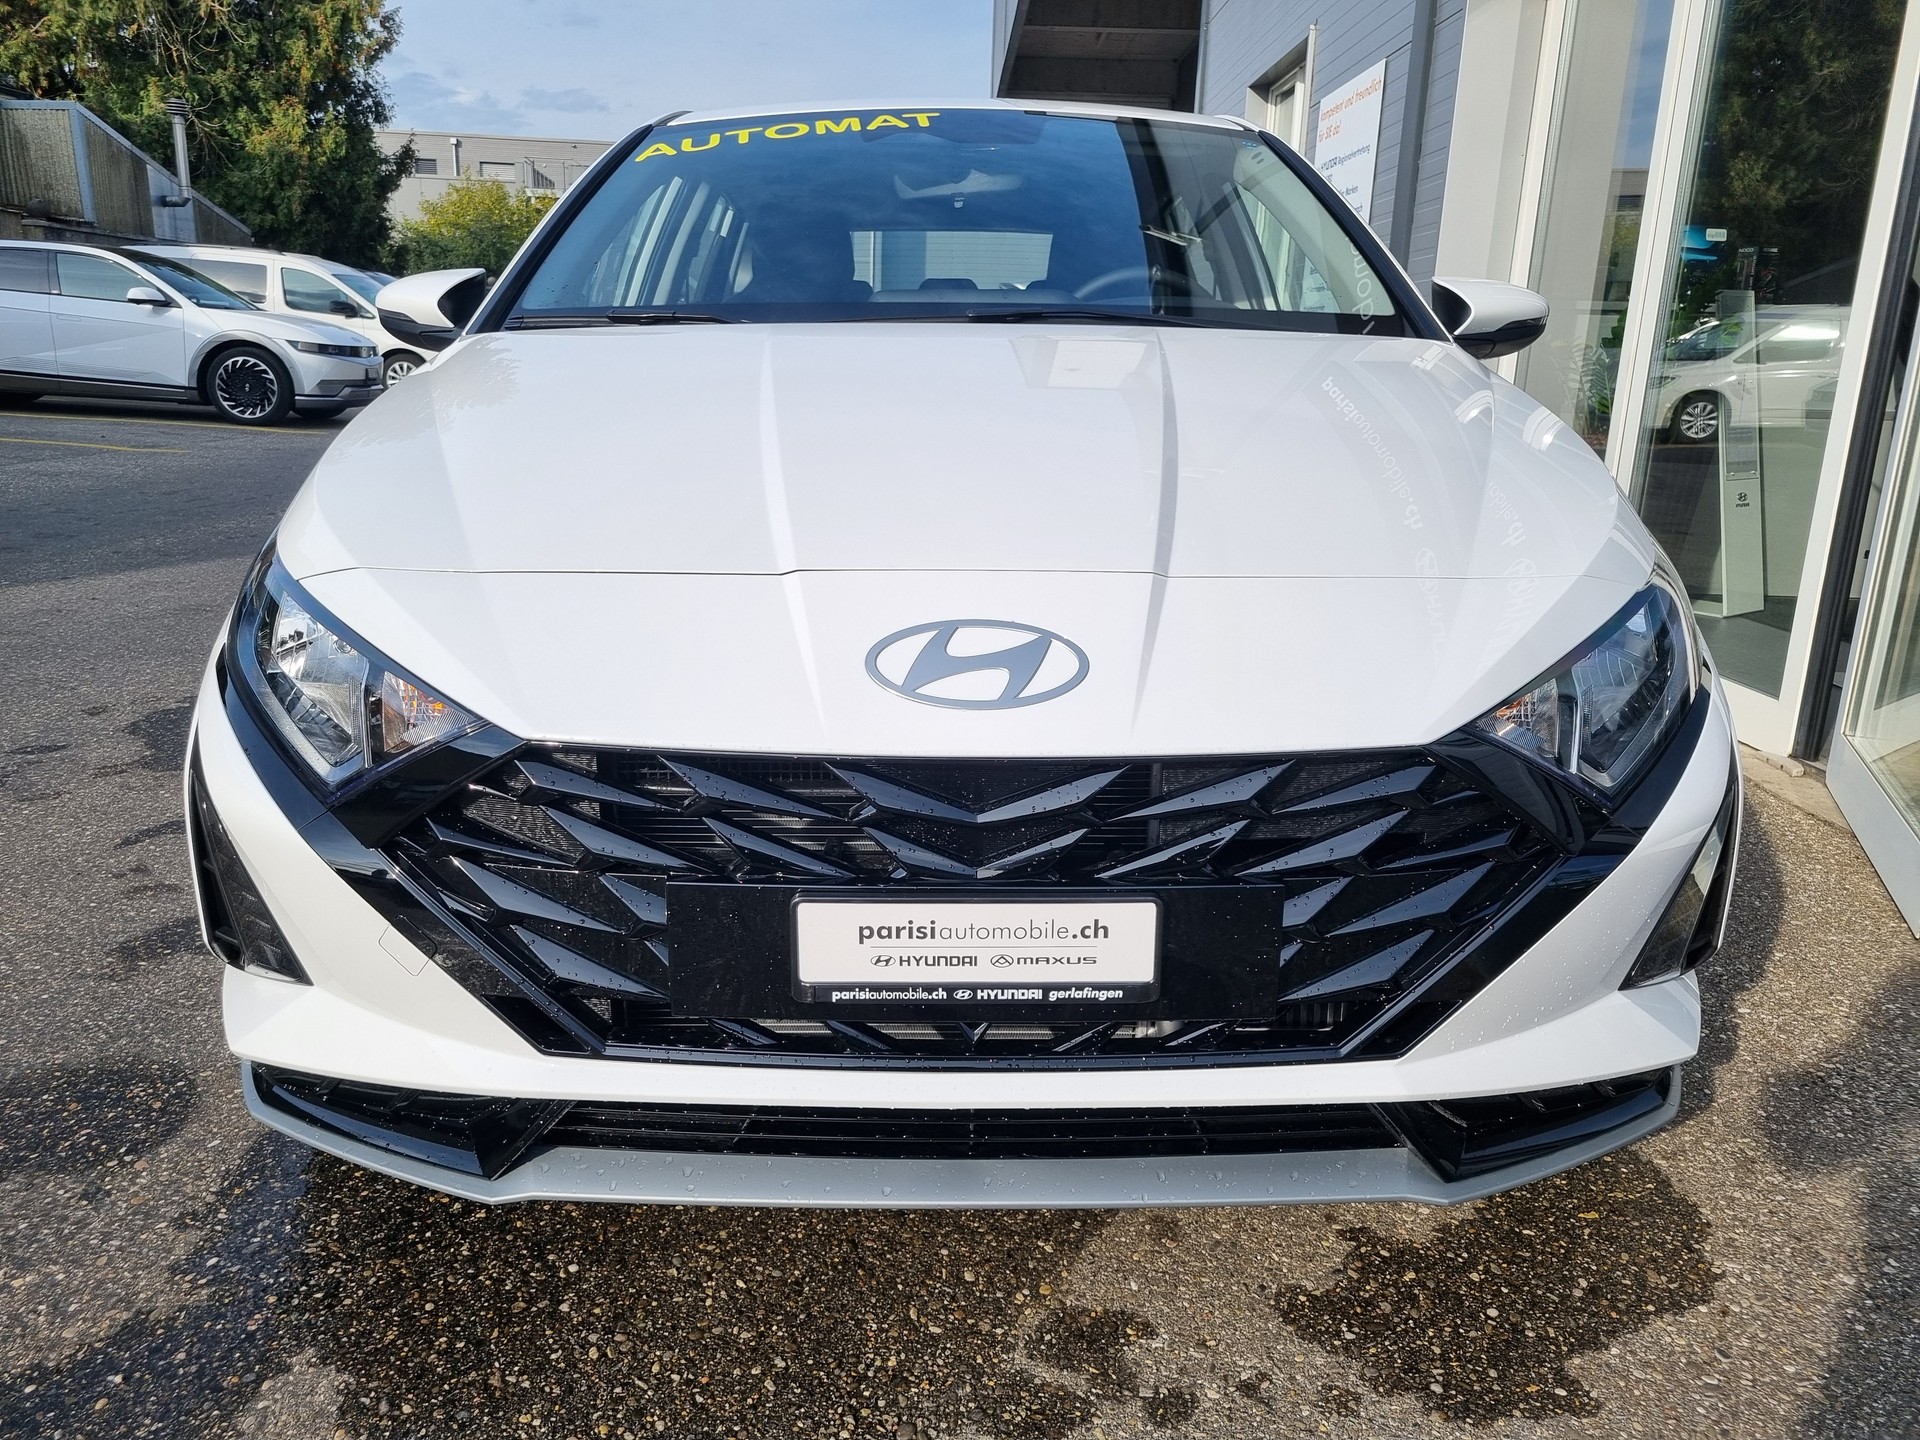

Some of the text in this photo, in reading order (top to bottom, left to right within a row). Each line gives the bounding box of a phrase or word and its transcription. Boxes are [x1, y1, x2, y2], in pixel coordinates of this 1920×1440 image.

[635, 113, 941, 162] AUTOMAT
[858, 918, 1109, 944] parisiautomobile.ch
[899, 955, 978, 967] HYUNDAI
[831, 986, 1124, 1003] parisiautomobile.ch HYUNDAI gerlafingen
